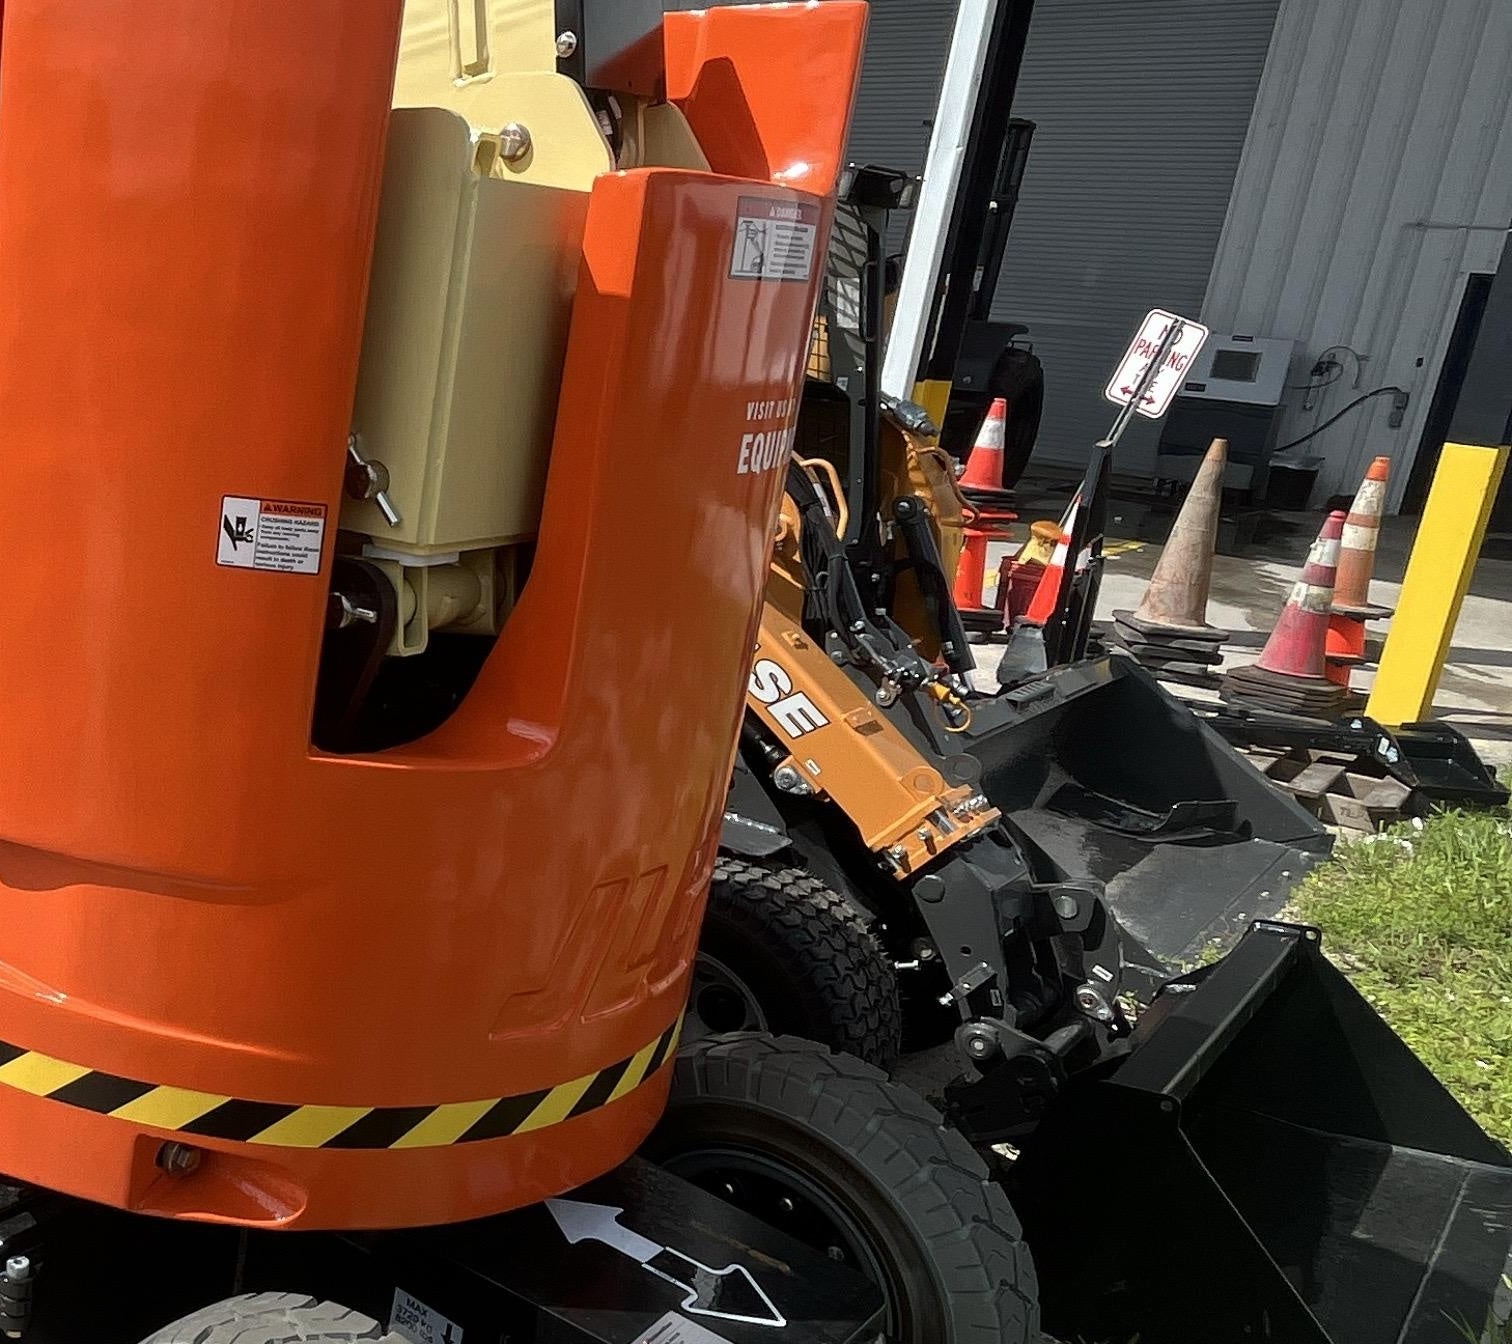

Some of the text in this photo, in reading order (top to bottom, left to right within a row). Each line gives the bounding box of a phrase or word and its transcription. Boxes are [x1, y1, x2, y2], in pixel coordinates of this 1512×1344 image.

[746, 400, 776, 421] VISIT
[272, 503, 323, 516] WARNING
[748, 658, 831, 739] SE
